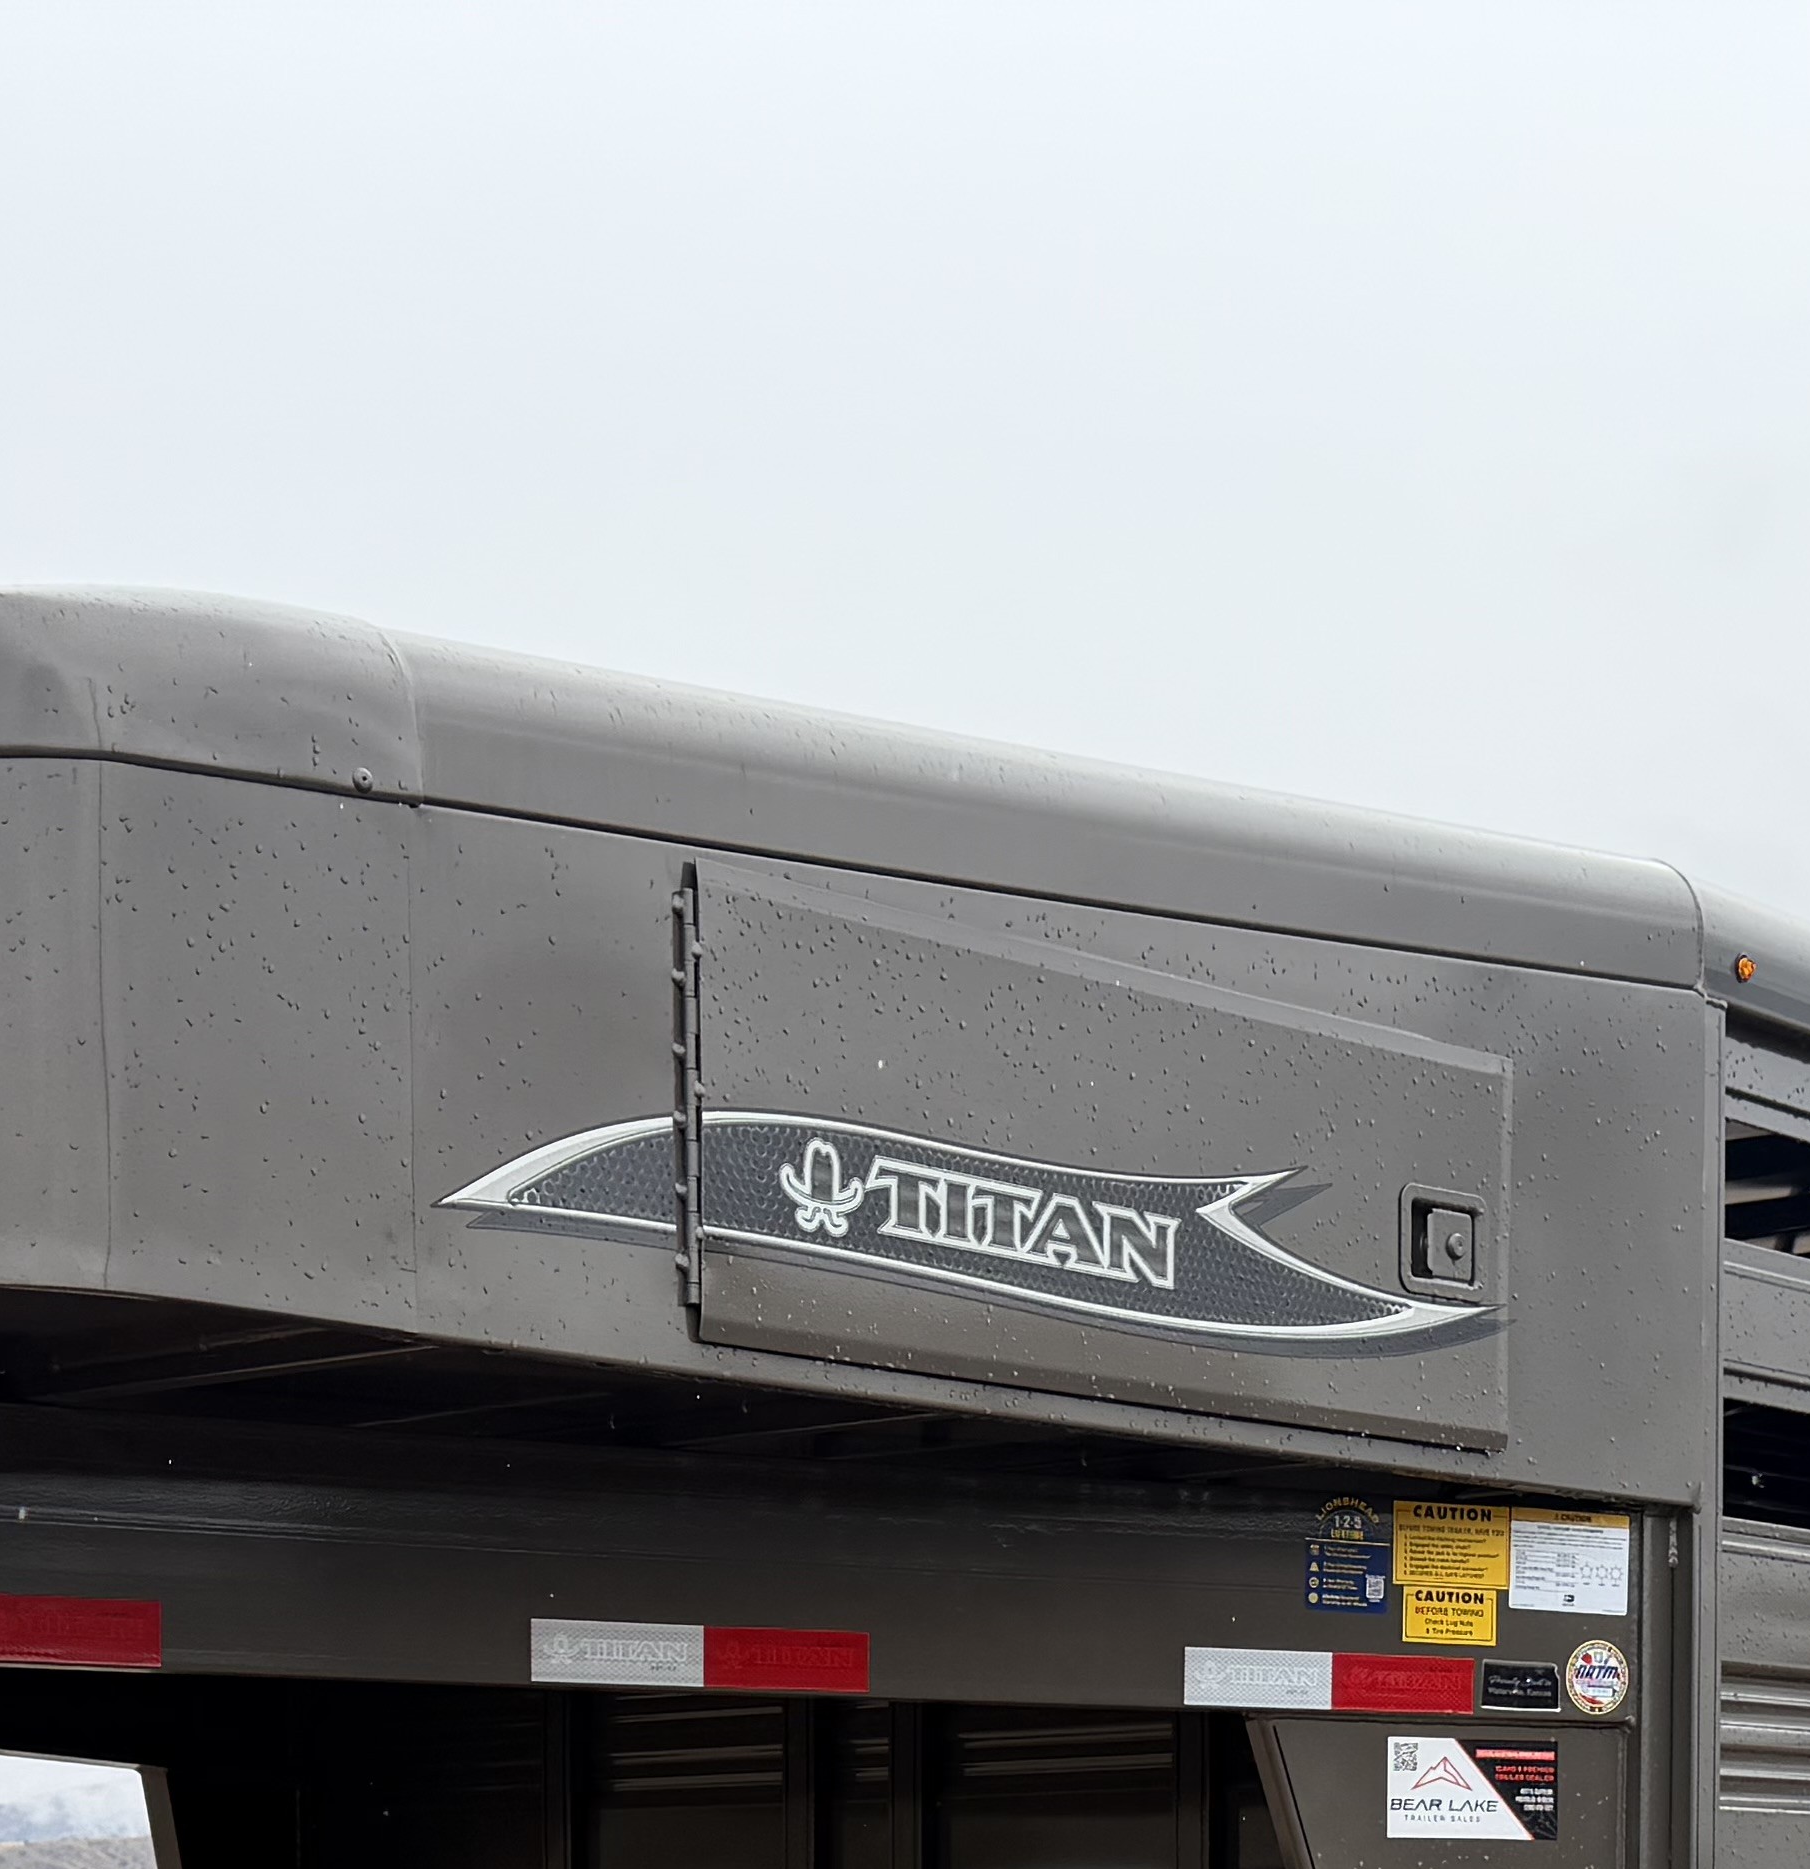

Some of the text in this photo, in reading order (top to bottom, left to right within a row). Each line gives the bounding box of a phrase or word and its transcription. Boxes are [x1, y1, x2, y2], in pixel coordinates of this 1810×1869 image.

[864, 1155, 1182, 1290] TITAN
[1413, 1504, 1492, 1522] CAUTION
[1414, 1589, 1485, 1605] CAUTION
[1415, 1606, 1448, 1616] BEFORE
[1390, 1798, 1442, 1812] BEAR
[1448, 1799, 1499, 1813] LAKE
[1404, 1814, 1482, 1824] TRAILER SALES
